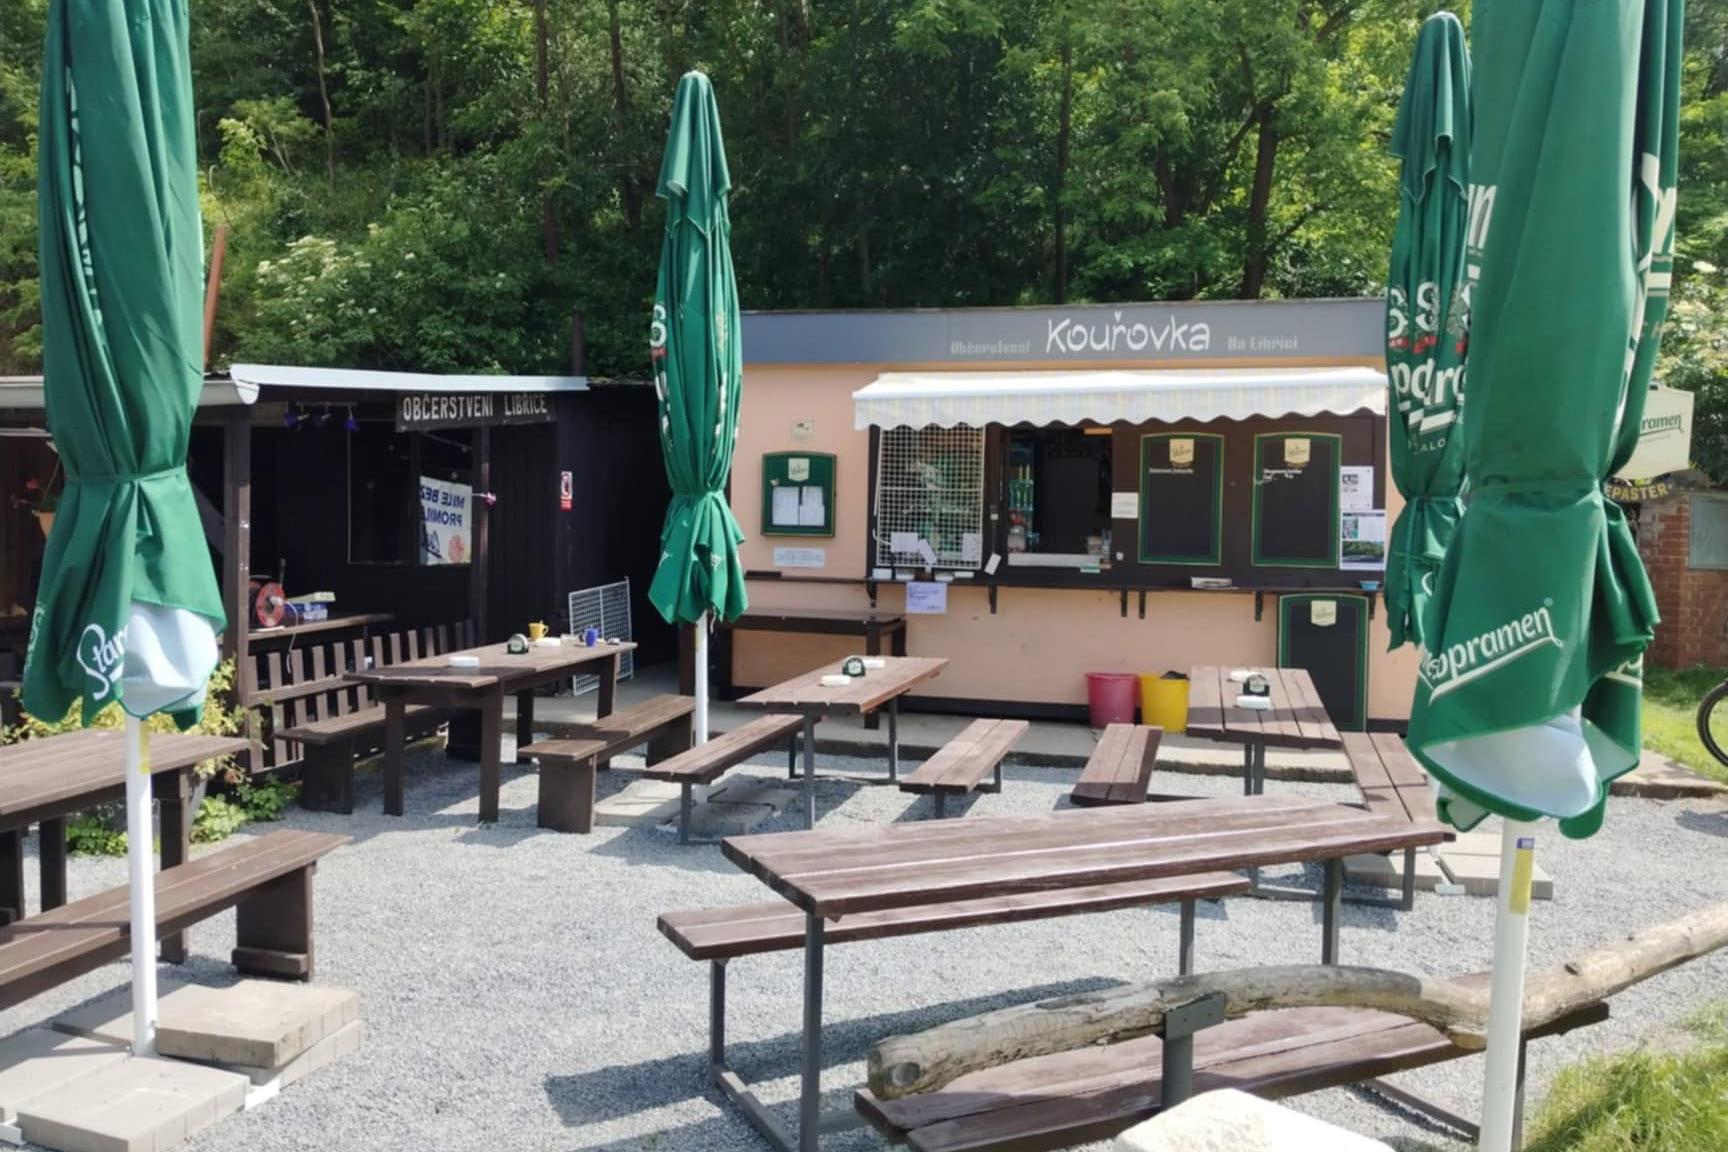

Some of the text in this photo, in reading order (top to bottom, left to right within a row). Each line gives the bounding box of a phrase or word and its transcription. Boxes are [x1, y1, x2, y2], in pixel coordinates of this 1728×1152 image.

[1046, 310, 1211, 353] Kouřovka
[1641, 415, 1682, 433] ramen
[77, 623, 128, 700] Star
